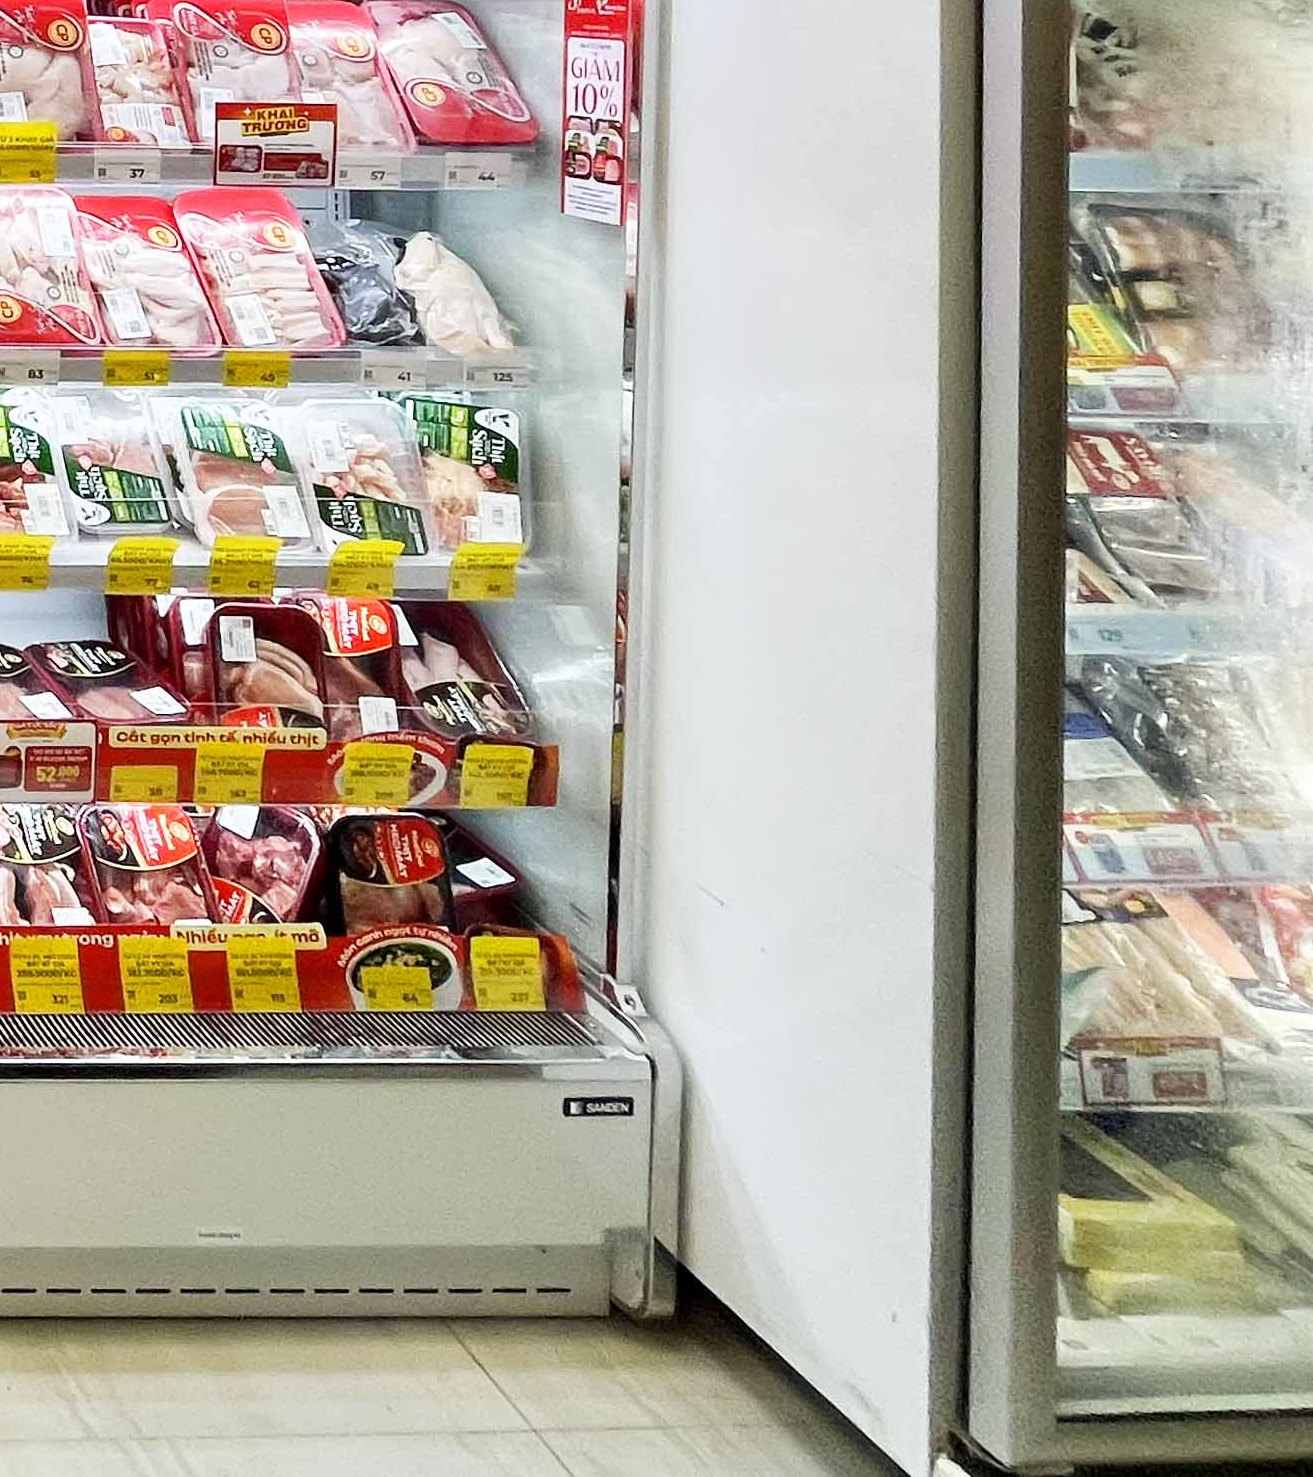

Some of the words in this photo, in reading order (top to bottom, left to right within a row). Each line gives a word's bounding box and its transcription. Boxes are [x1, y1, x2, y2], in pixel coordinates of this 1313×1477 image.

[573, 83, 618, 118] 10%
[257, 108, 294, 121] KHAI
[129, 168, 145, 179] 37
[370, 170, 386, 181] 57
[398, 371, 411, 382] 41
